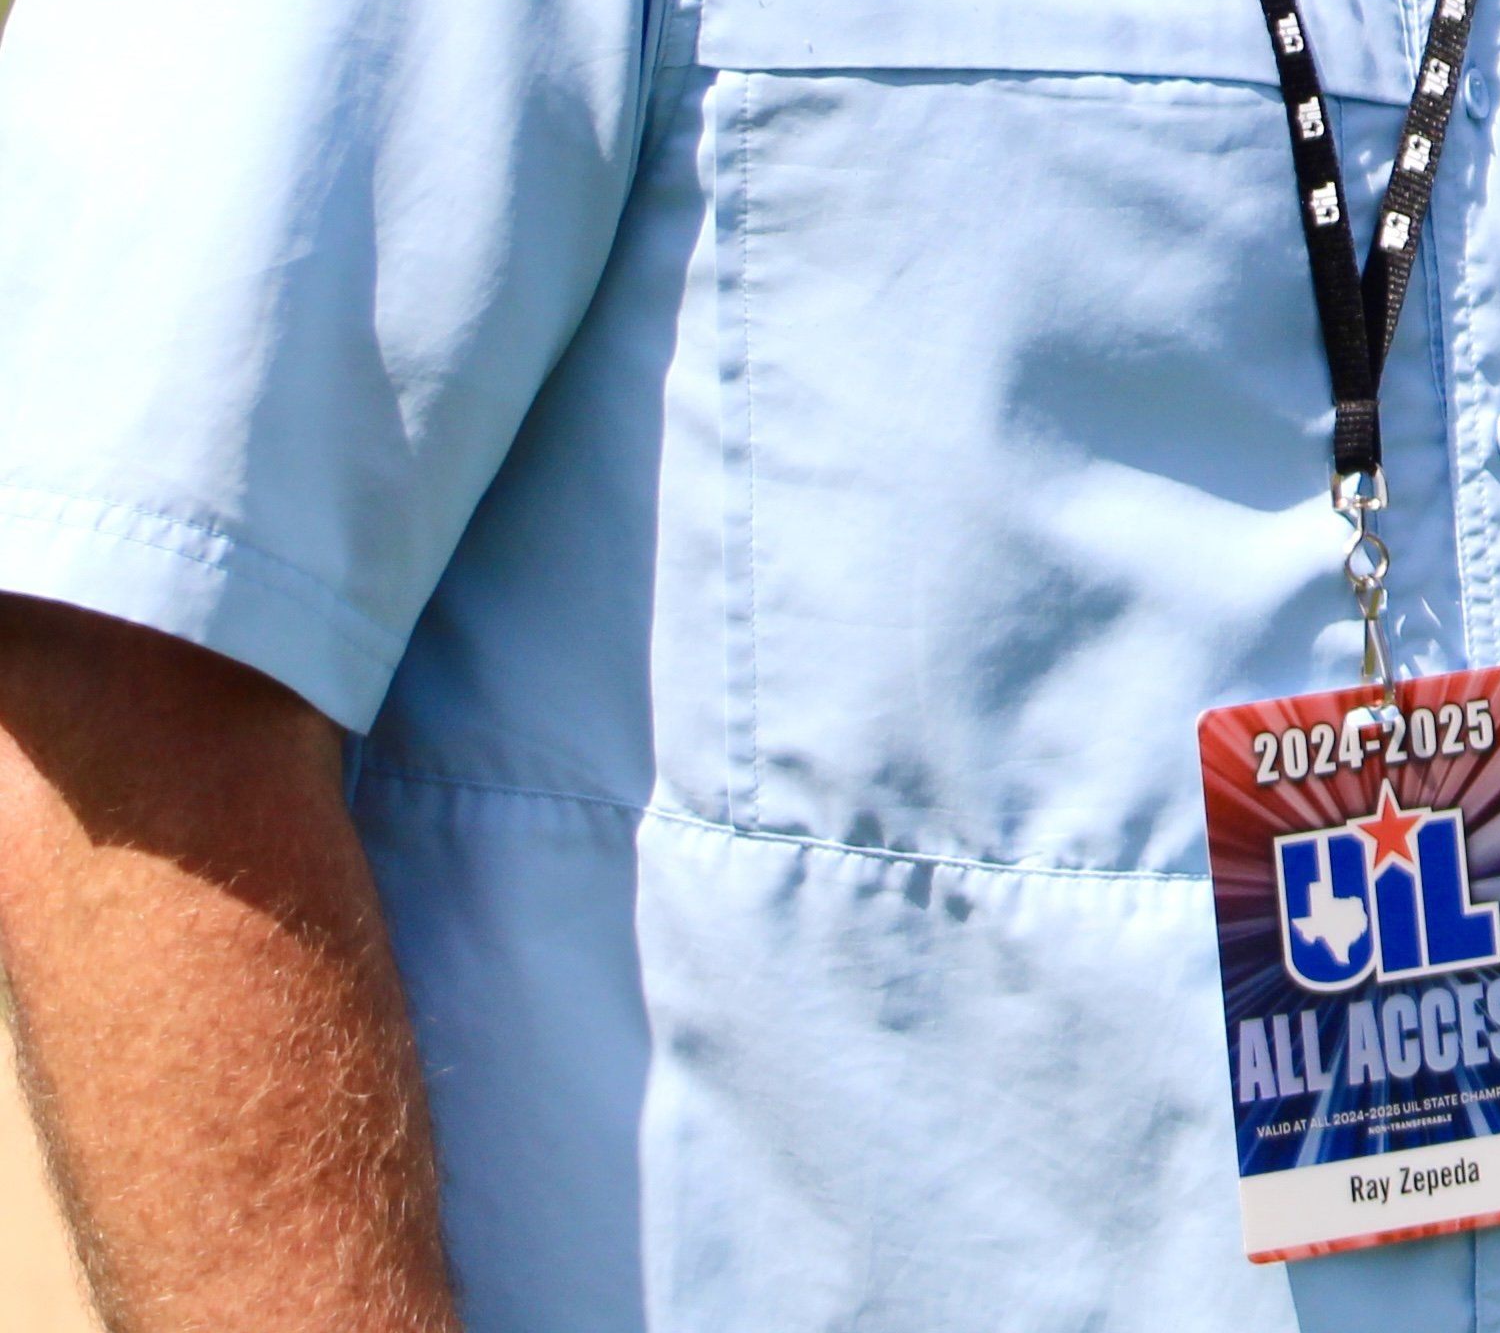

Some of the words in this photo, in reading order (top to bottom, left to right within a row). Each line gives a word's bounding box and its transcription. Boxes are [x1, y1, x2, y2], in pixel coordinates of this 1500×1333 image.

[1252, 699, 1495, 784] 2024-2025
[1238, 1009, 1334, 1103] ALL
[1256, 1120, 1292, 1138] VALID
[1293, 1118, 1308, 1132] AT
[1310, 1115, 1332, 1129] ALL
[1333, 1104, 1401, 1126] 2024-2025
[1402, 1099, 1421, 1115] UIL
[1423, 1094, 1459, 1111] STATE
[1367, 1113, 1453, 1135] NON-TRANSFERABLE
[1350, 1174, 1391, 1205] Ray
[1399, 1157, 1480, 1197] Zepeda
